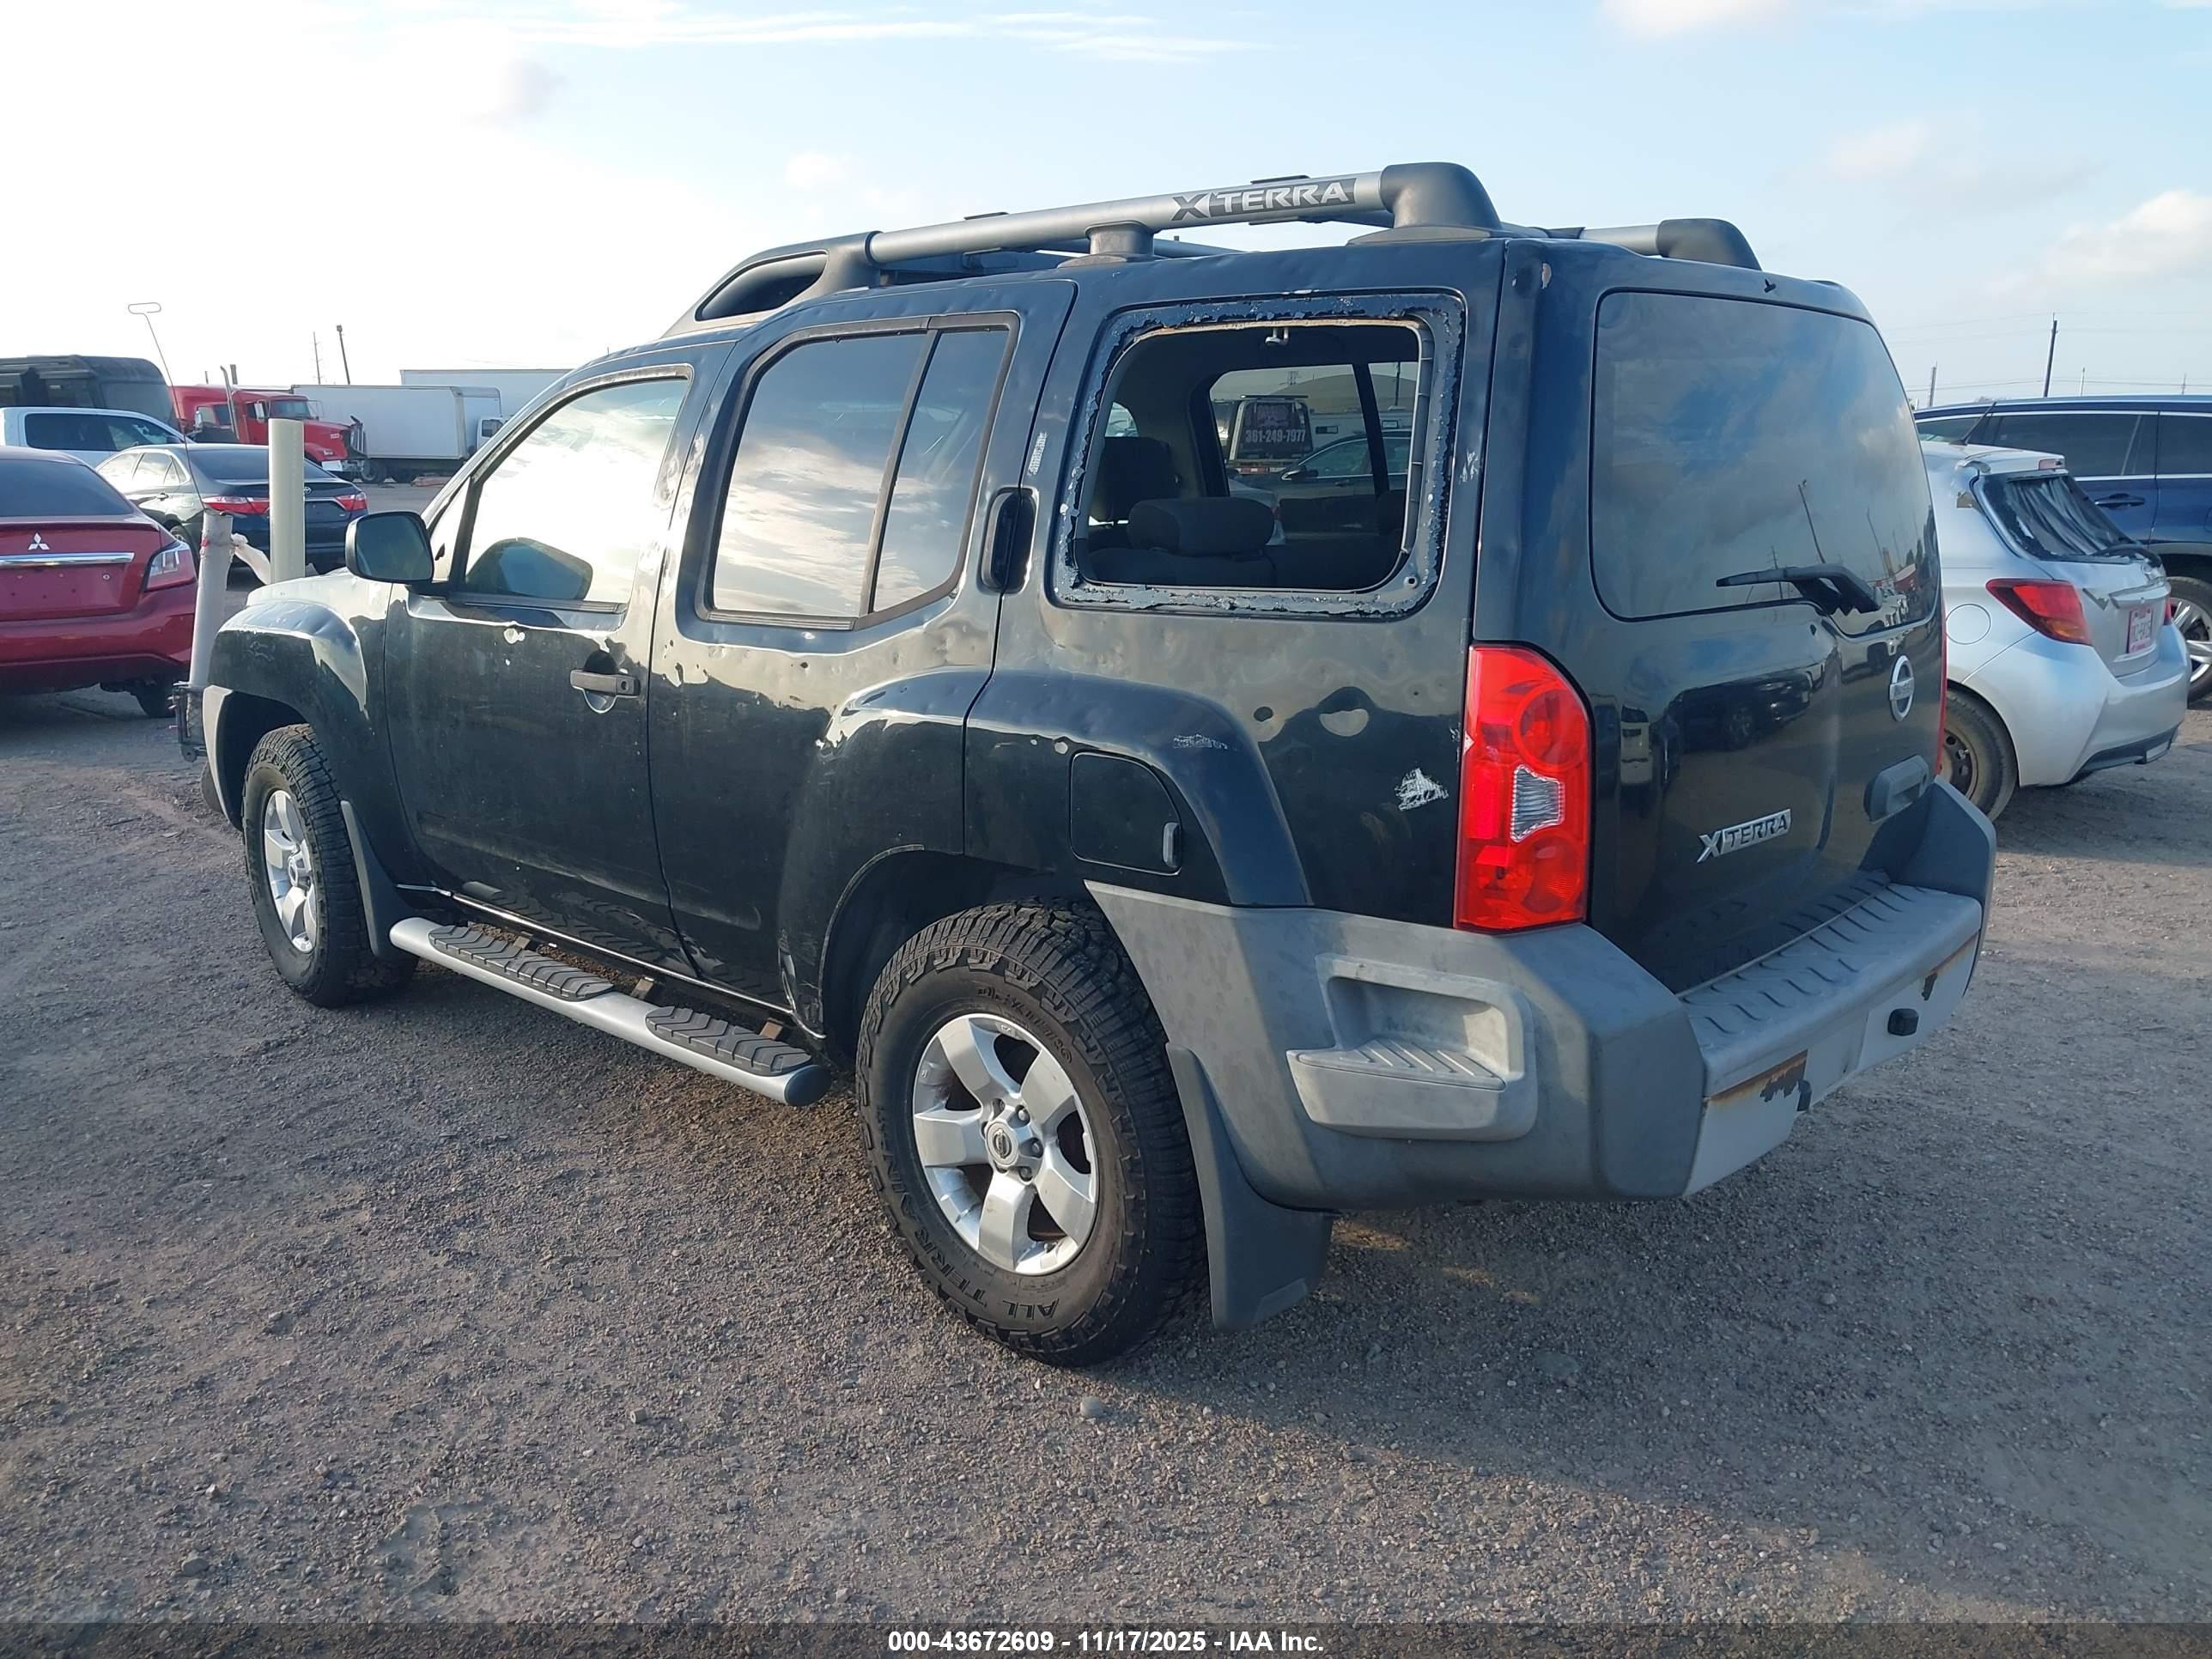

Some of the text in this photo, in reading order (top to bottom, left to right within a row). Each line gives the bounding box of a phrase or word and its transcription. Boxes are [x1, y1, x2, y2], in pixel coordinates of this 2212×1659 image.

[1170, 180, 1351, 222] XTERRA
[1697, 808, 1791, 863] XTERRA
[1002, 1297, 1060, 1321] ALL
